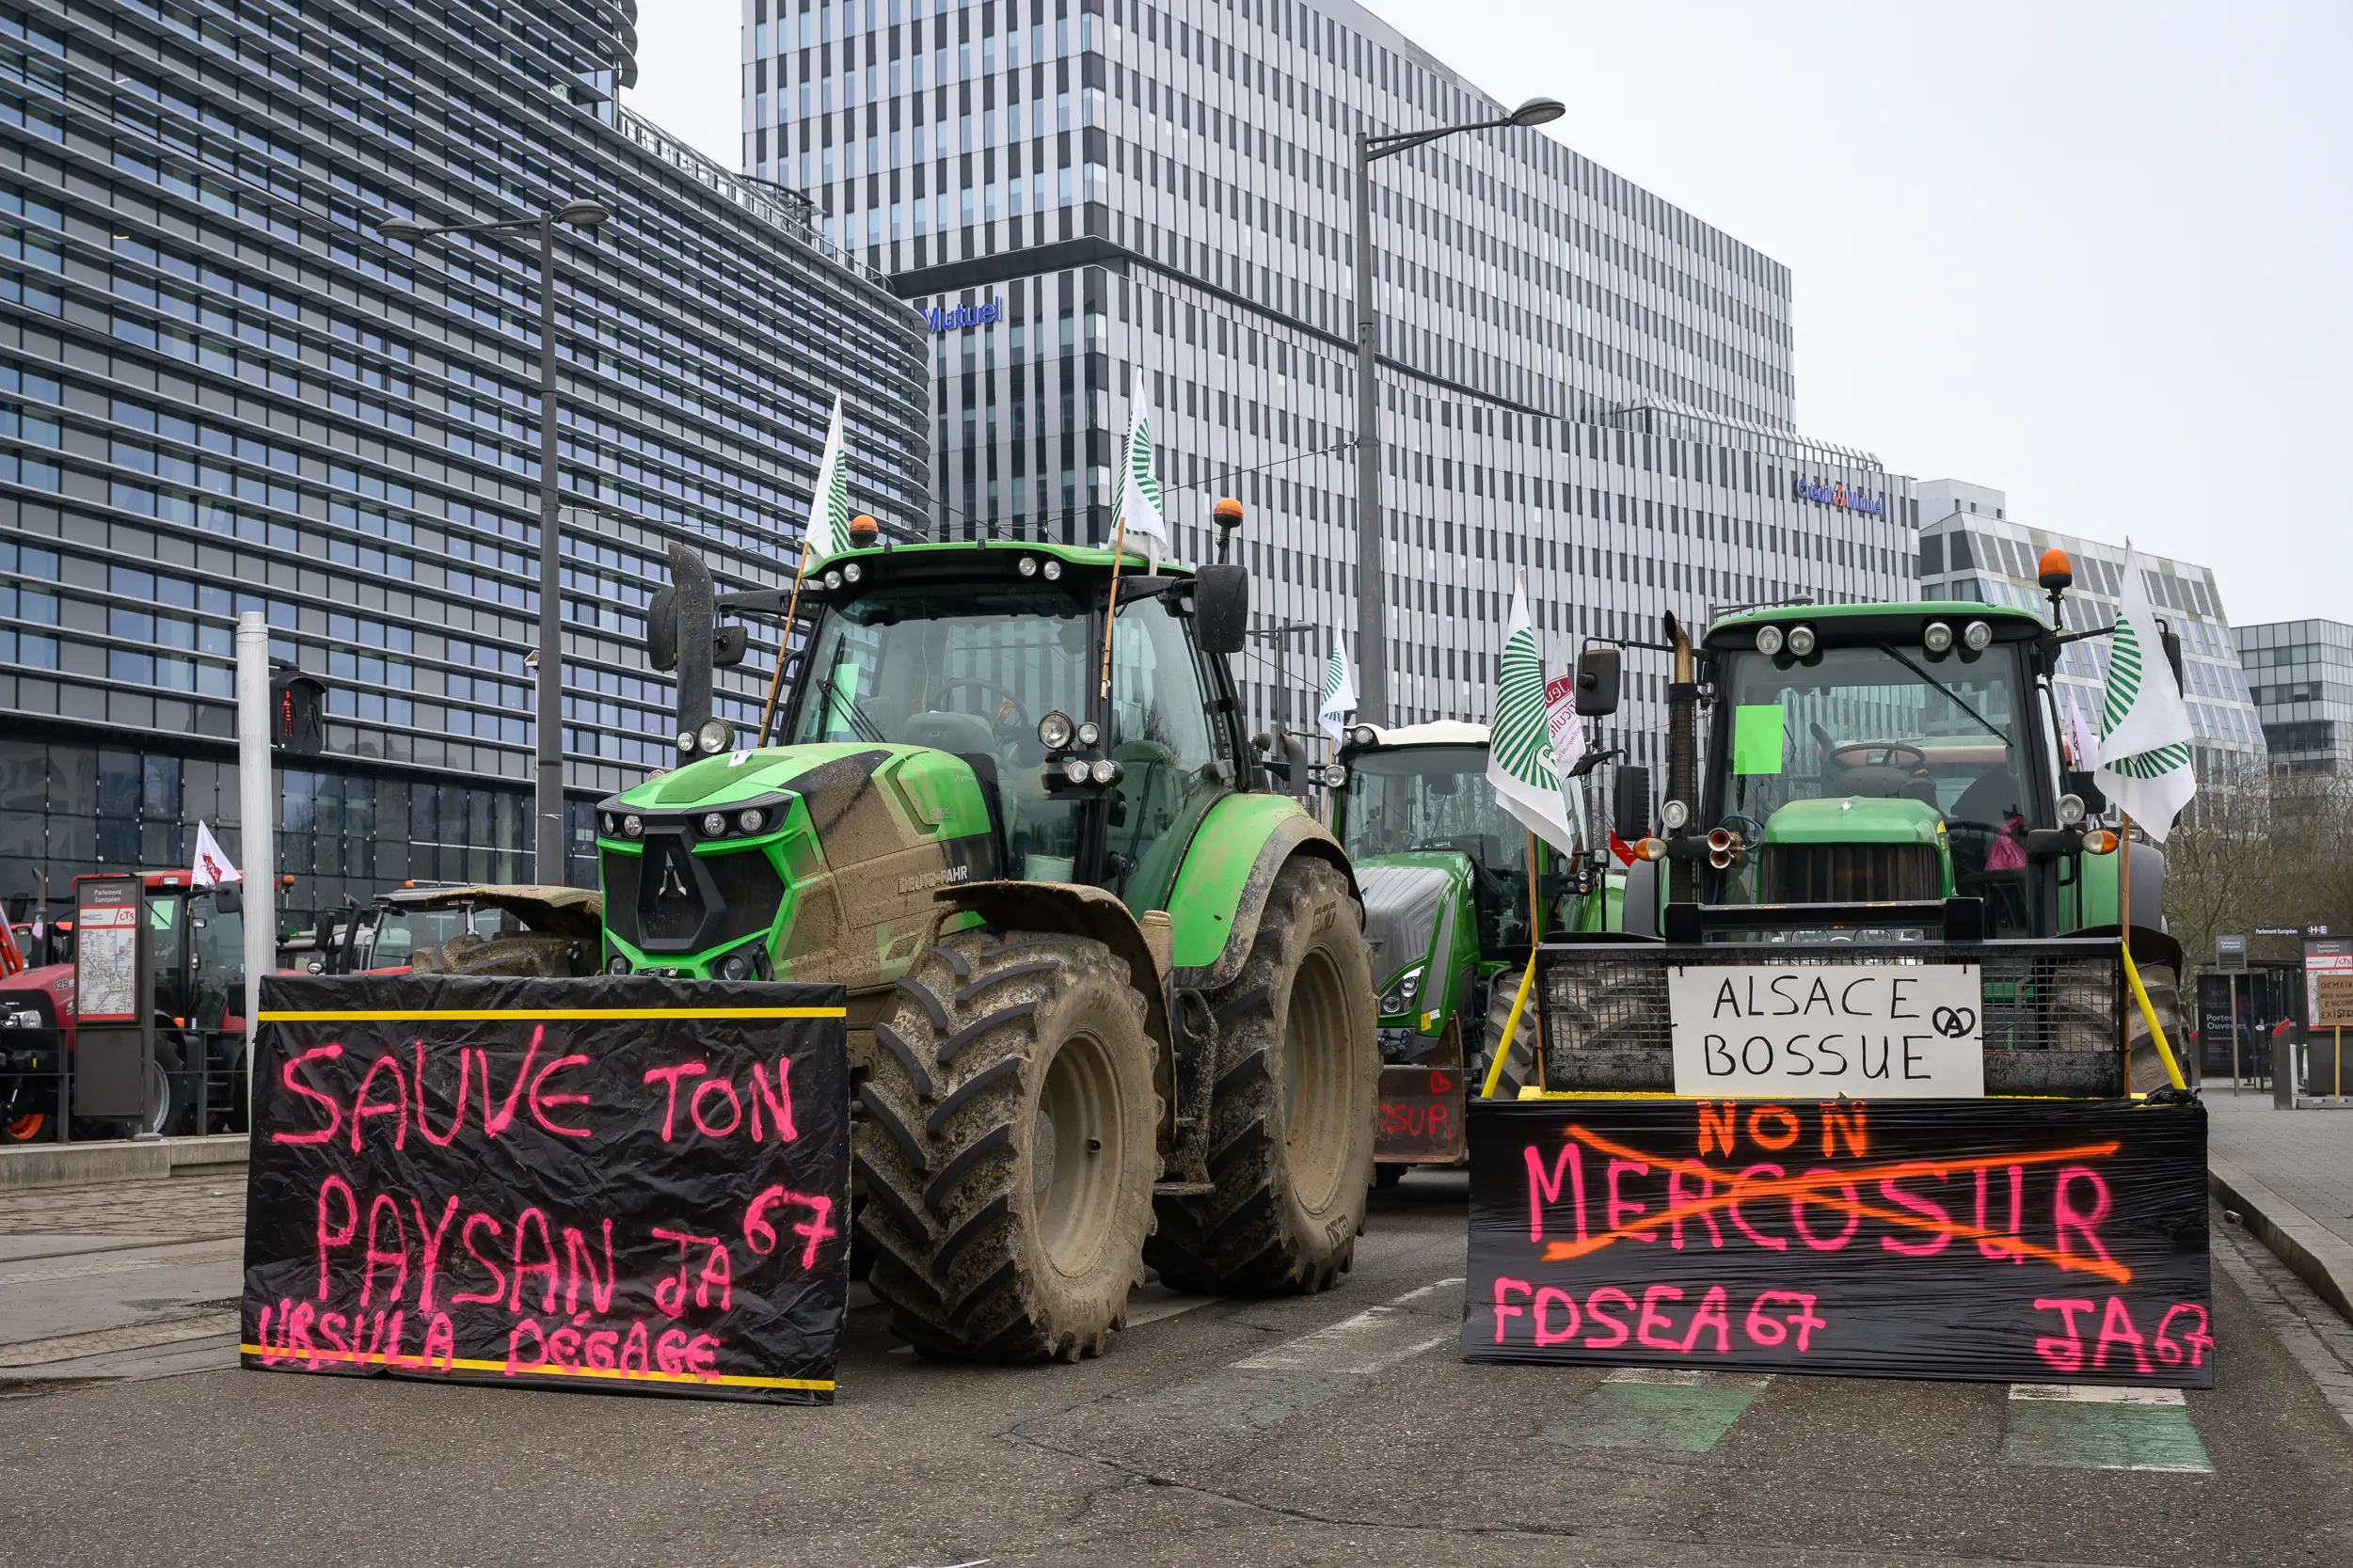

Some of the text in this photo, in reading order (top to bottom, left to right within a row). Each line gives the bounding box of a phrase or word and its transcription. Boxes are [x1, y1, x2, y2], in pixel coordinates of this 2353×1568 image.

[920, 295, 1002, 333] Mutuel
[1798, 477, 1884, 515] Crédit Mutuel
[2278, 927, 2298, 936] Européen
[1713, 974, 1920, 1020] ALSACE
[2320, 981, 2353, 990] DEMAIN
[1705, 1034, 1933, 1080] BOSSUE
[272, 1024, 798, 1153] SAUVE TON
[1697, 1098, 1868, 1158] NON
[1524, 1143, 2113, 1271] MERCOSUR
[317, 1175, 835, 1317] PAYSAN JA 67
[258, 1298, 454, 1373] URSULA
[1493, 1276, 1827, 1354] FDSEA 67
[2032, 1295, 2214, 1373] JA 67
